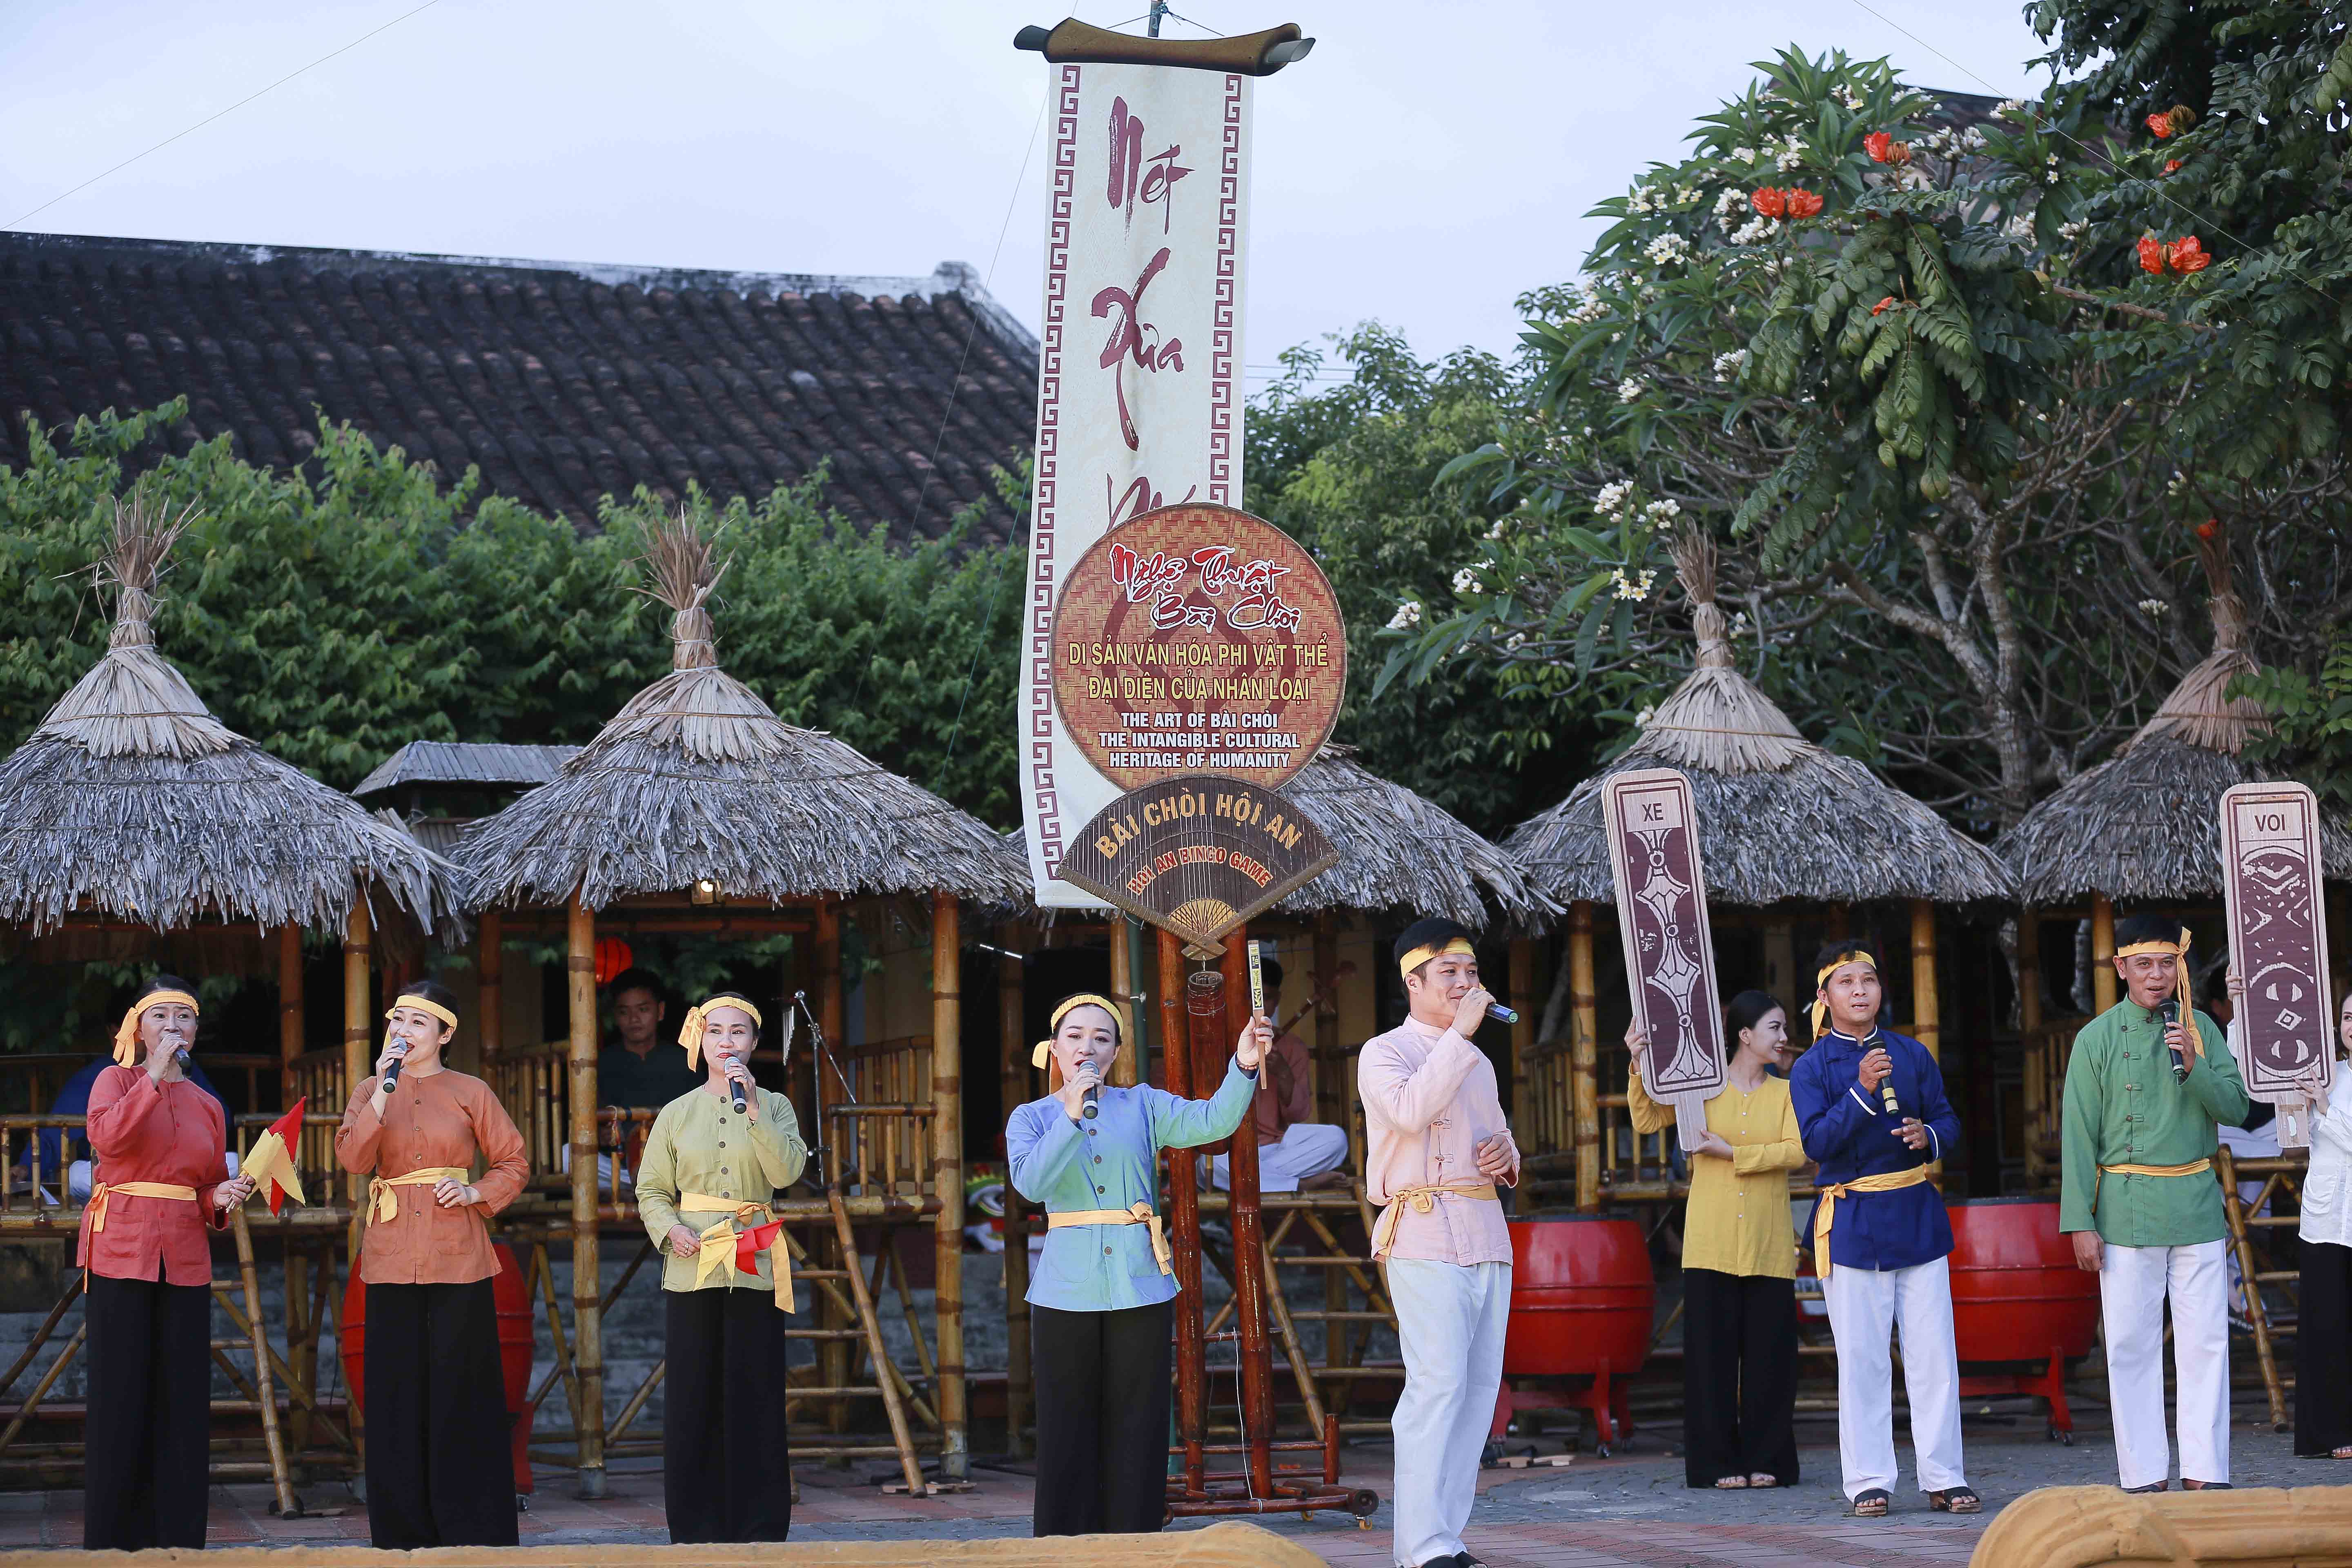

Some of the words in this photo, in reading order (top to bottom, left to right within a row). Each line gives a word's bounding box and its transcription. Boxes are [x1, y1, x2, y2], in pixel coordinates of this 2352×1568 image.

[1107, 96, 1195, 243] Nét
[1090, 247, 1185, 452] Xưa
[1109, 543, 1187, 602] Nghệ
[1192, 546, 1291, 596] Thuật
[1227, 594, 1301, 634] Chòi
[1069, 642, 1087, 665] DI
[1091, 634, 1128, 665] SẢN
[1132, 637, 1169, 665] VĂN
[1175, 637, 1213, 666] HÓA
[1218, 644, 1247, 666] PHI
[1252, 638, 1287, 671] VẬT
[1292, 633, 1327, 666] THỂ
[1088, 677, 1118, 704] ĐẠI
[1124, 671, 1165, 704] DIỆN
[1171, 669, 1208, 700] CỦA
[1214, 672, 1263, 700] NHÂN
[1269, 678, 1309, 706] LOẠI
[1121, 712, 1149, 728] THE
[1154, 713, 1183, 728] ART
[1187, 713, 1206, 728] OF
[1211, 710, 1237, 728] BÀI
[1241, 710, 1278, 728] CHÒI
[1098, 732, 1127, 747] THE
[1132, 733, 1221, 748] INTANGIBLE
[1225, 733, 1301, 748] CULTURAL
[1109, 752, 1183, 767] HERITAGE
[1186, 752, 1205, 767] OF
[1210, 753, 1290, 768] HUMANITY
[1094, 814, 1141, 860] BÀI
[1144, 787, 1205, 826] CHÒI
[1216, 791, 1263, 827] HỘI
[1263, 814, 1303, 850] AN
[1642, 802, 1664, 822] XE
[2254, 814, 2286, 832] VOI
[1127, 865, 1157, 896] HOI
[1154, 851, 1178, 875] AN
[1178, 846, 1227, 865] BINGO
[1229, 851, 1274, 888] GAME
